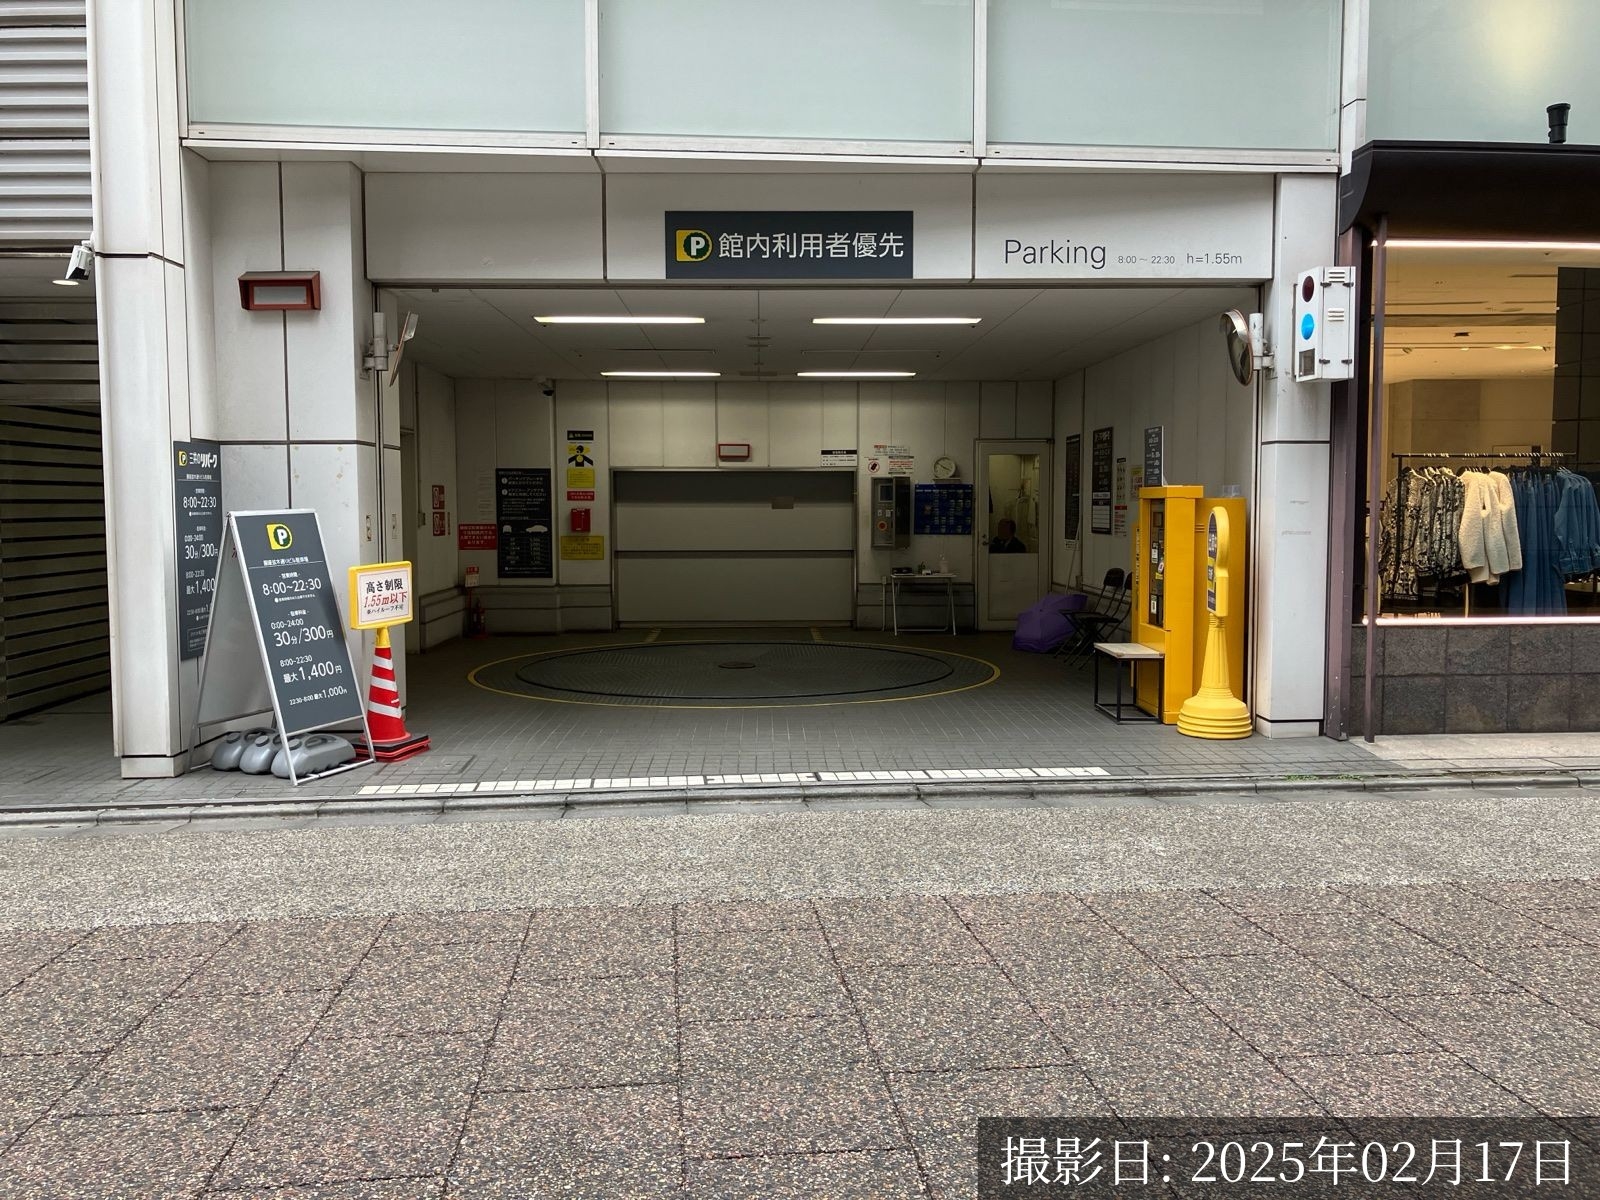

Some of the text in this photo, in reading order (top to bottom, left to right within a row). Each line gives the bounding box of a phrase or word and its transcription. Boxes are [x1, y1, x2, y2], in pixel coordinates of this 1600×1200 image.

[718, 231, 904, 259] 館内利用者優先
[1004, 239, 1106, 270] Parking
[1186, 253, 1242, 265] h=1.55m
[182, 496, 217, 510] 8:00~22:30
[262, 577, 322, 596] 8:00~22:30
[366, 578, 404, 594] 高さ制限
[364, 591, 408, 608] 1.55m以下
[273, 625, 334, 647] 30分/300円
